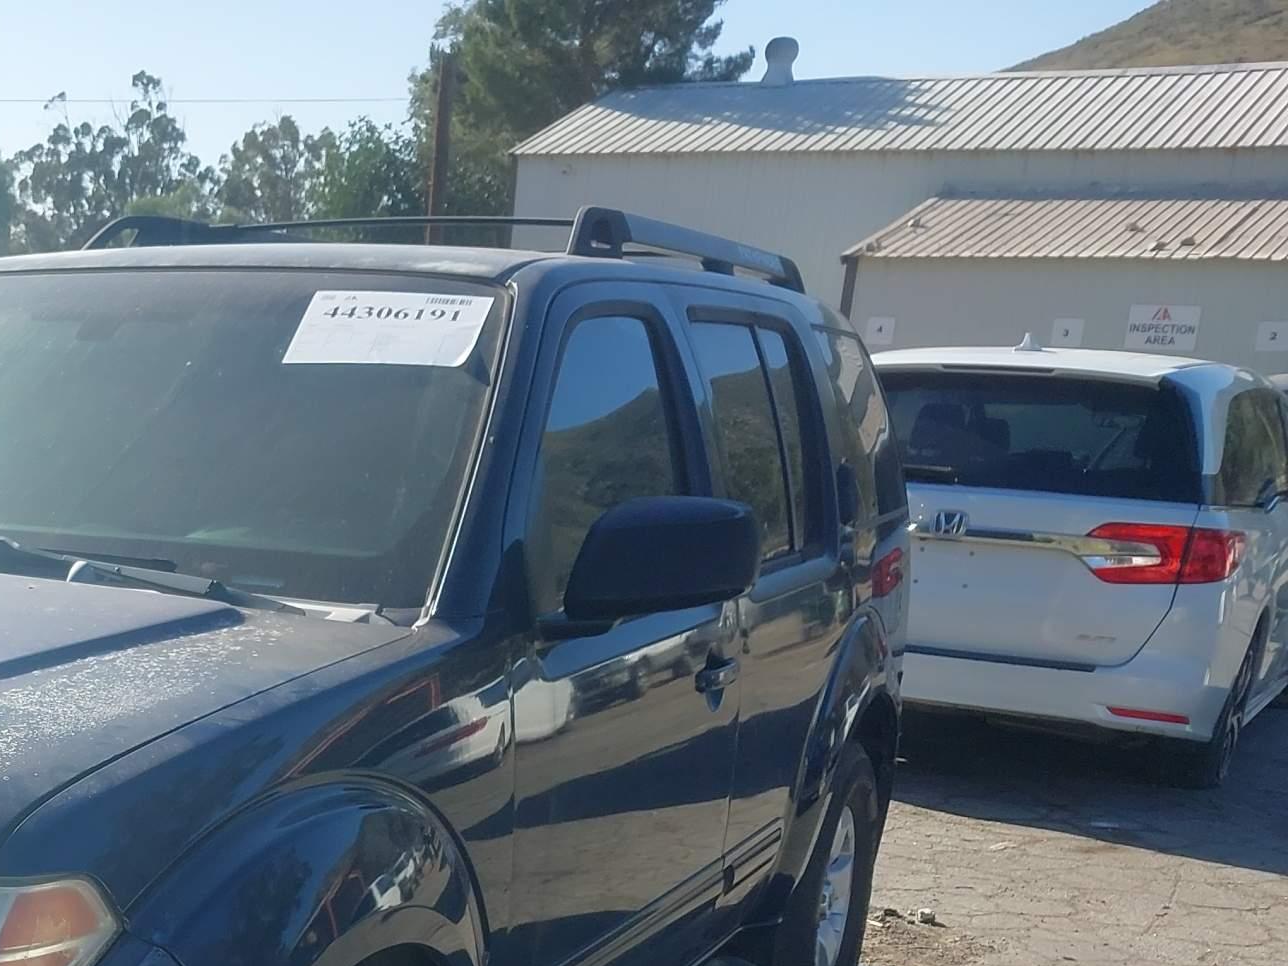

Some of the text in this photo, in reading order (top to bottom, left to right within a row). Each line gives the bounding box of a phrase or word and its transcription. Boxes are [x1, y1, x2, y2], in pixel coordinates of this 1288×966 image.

[324, 306, 461, 321] 44306191
[1129, 323, 1196, 335] INSPECTION
[1144, 335, 1176, 345] AREA
[1269, 331, 1278, 341] 2
